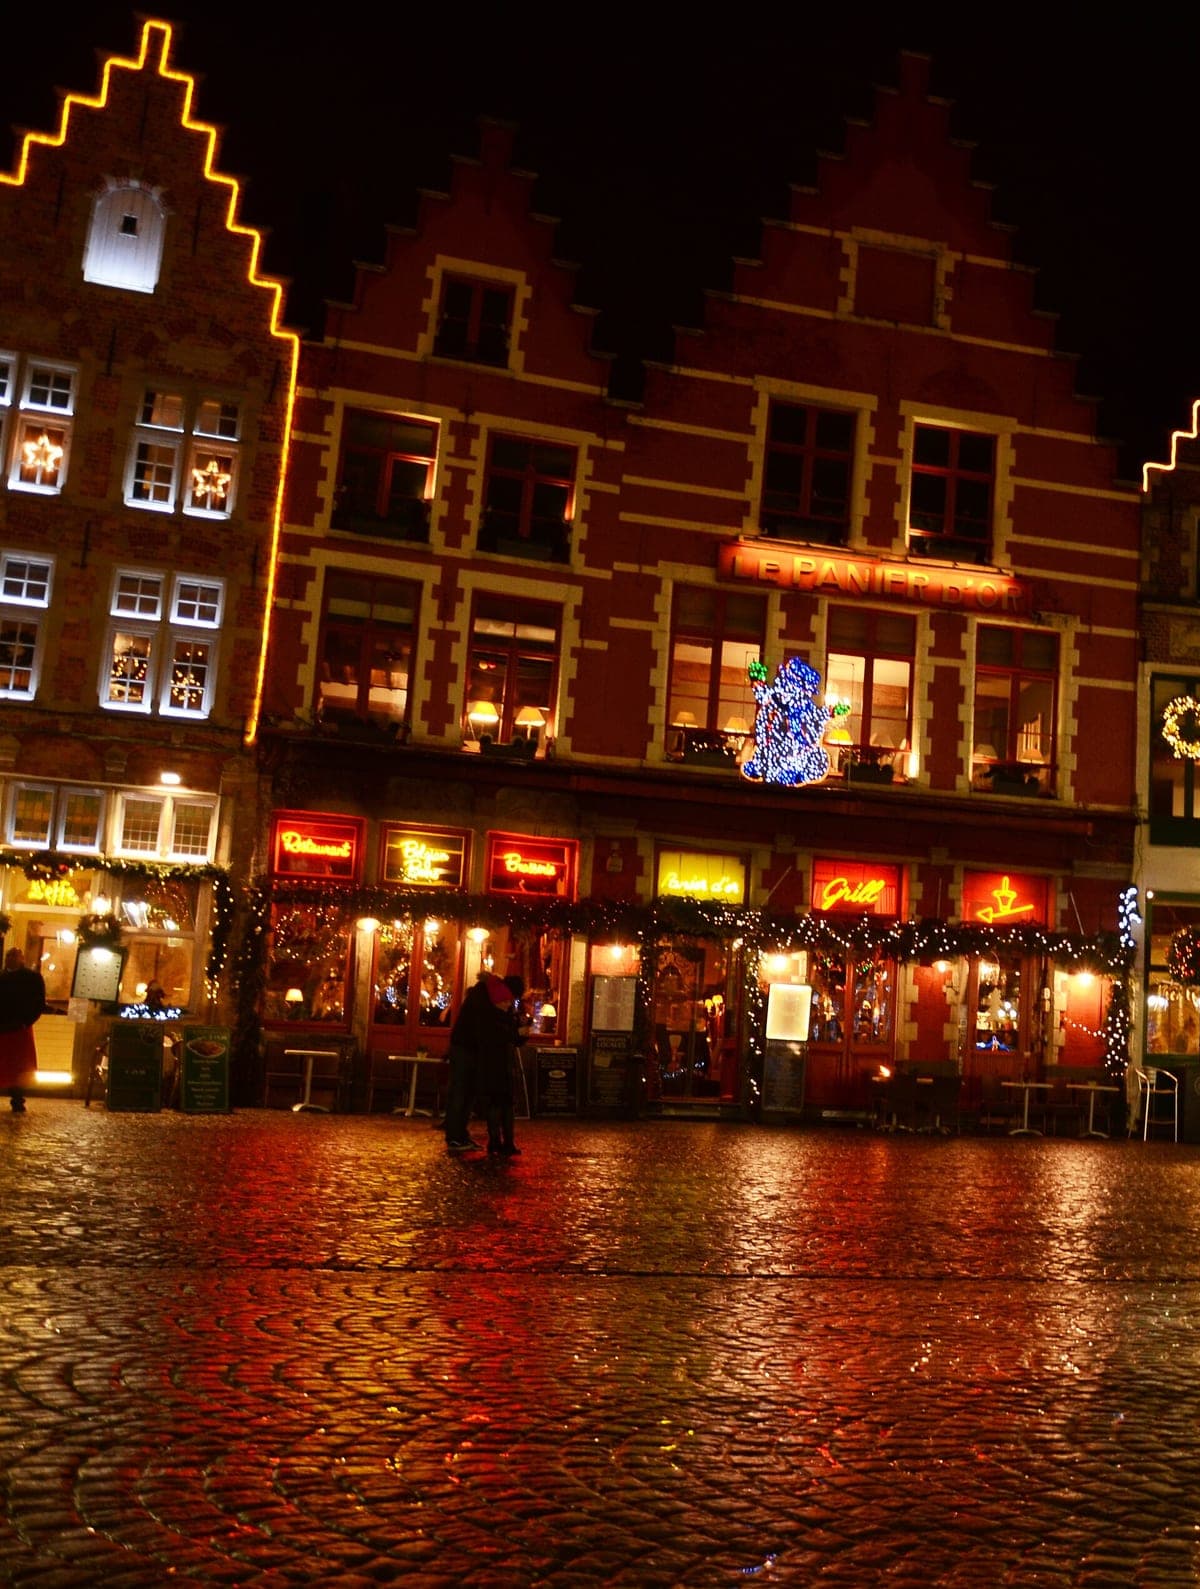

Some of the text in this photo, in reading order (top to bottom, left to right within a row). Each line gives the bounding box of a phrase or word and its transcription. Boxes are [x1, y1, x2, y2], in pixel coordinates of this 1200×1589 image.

[733, 555, 780, 583] LE
[793, 557, 930, 601] PANIER
[281, 831, 352, 858] Restaurant
[821, 877, 886, 911] Grill
